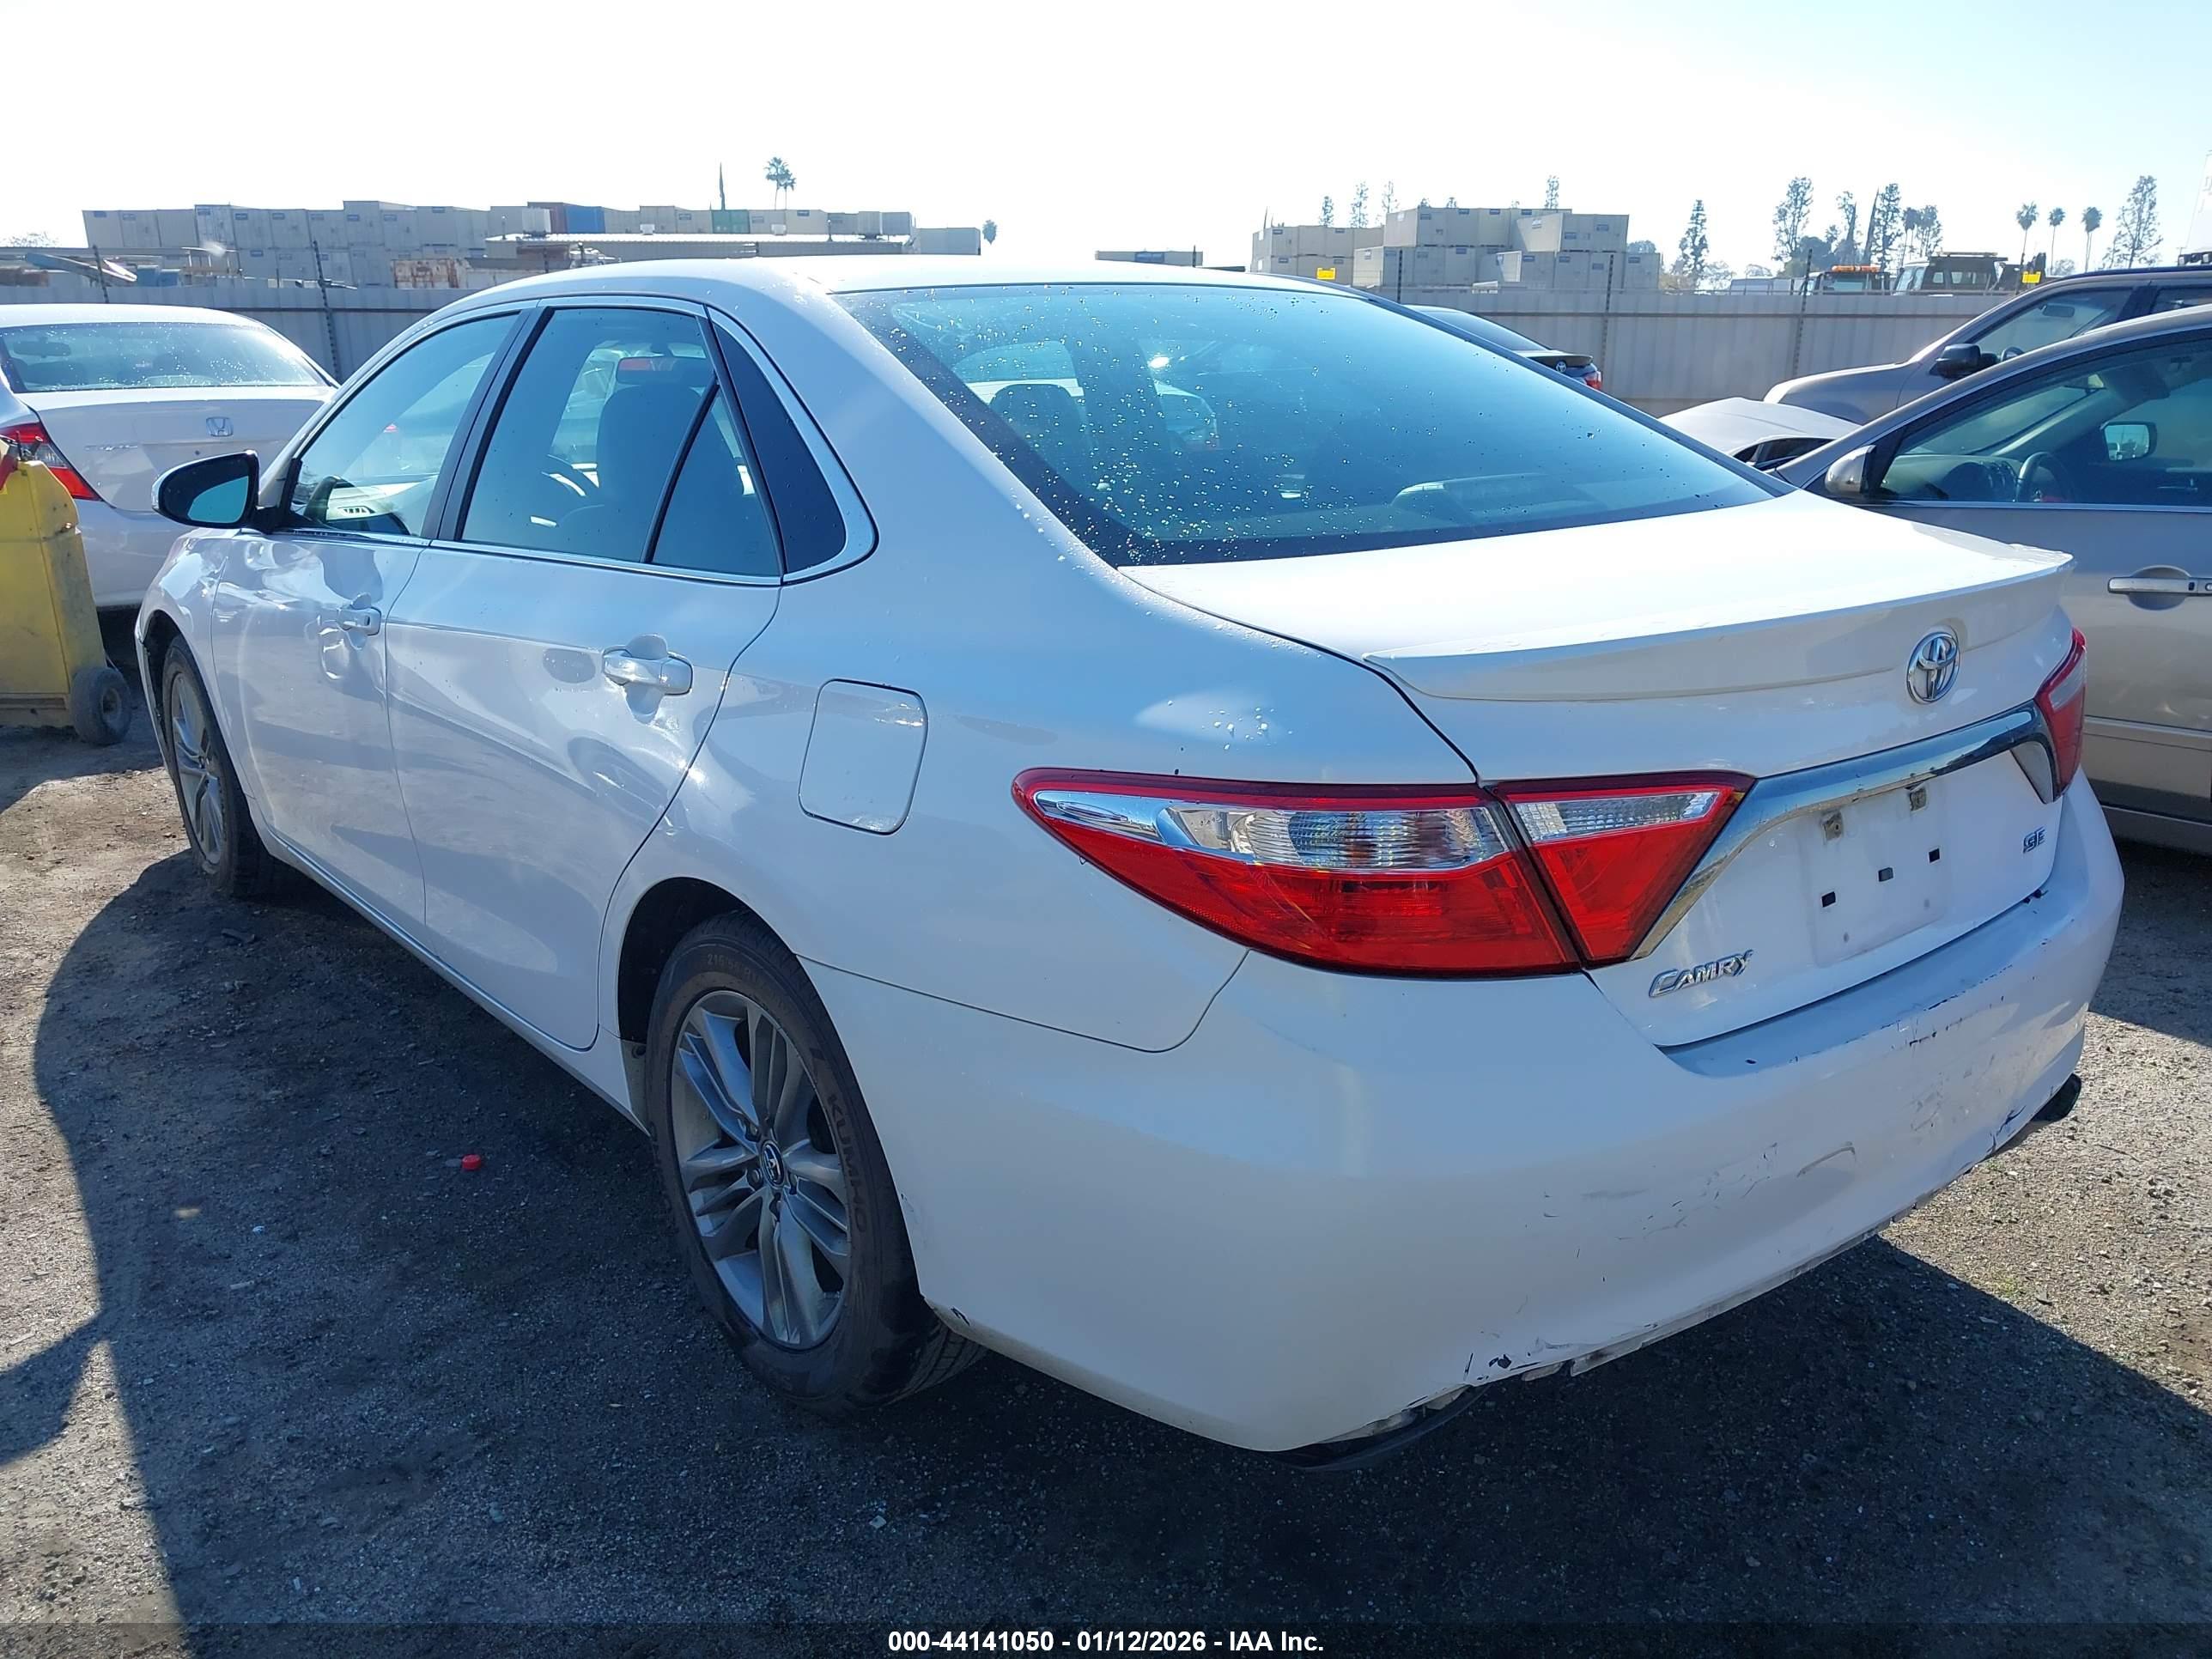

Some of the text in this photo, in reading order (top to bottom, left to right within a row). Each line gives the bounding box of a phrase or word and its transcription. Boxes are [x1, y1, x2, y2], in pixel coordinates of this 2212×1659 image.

[2023, 826, 2045, 853] SE
[1649, 950, 1753, 998] CAMRY
[827, 1093, 866, 1233] KUMHO
